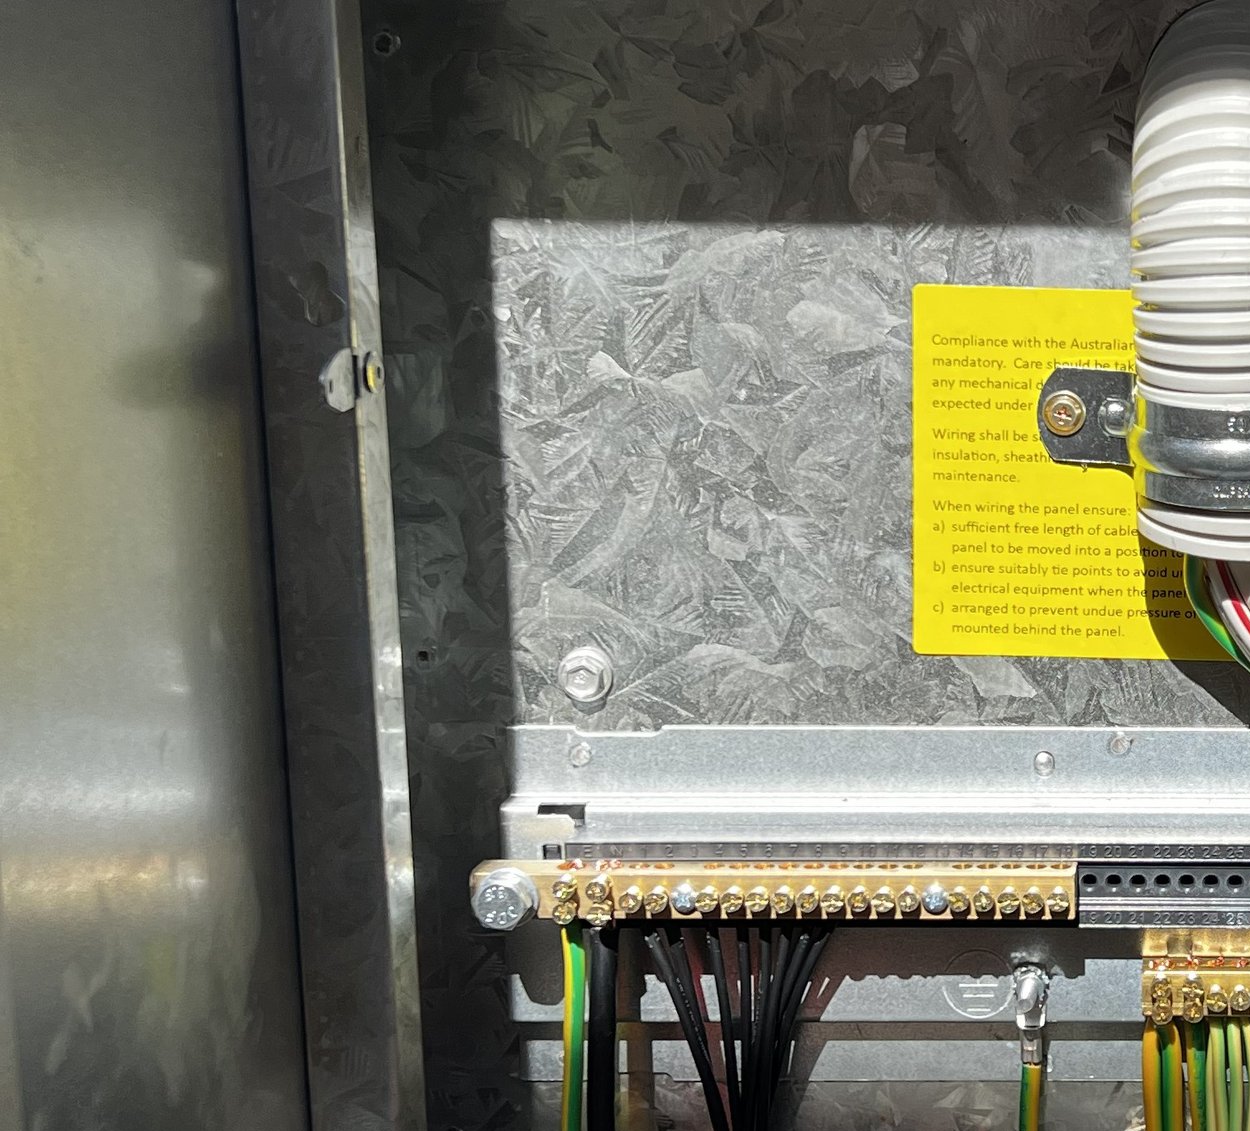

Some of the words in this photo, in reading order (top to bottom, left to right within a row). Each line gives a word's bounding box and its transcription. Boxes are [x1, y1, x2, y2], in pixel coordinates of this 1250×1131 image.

[931, 334, 1009, 348] Compliance
[1012, 336, 1041, 349] with
[1045, 336, 1067, 350] the
[932, 356, 1007, 370] mandatory.
[1013, 358, 1043, 370] Care
[1114, 361, 1135, 372] tak
[932, 378, 955, 391] any
[959, 378, 1032, 391] mechanical
[932, 398, 991, 413] expected
[995, 400, 1034, 412] under
[932, 429, 976, 443] Wiring
[979, 430, 1009, 442] shall
[1013, 430, 1029, 443] be
[932, 451, 1000, 465] insulation,
[1003, 452, 1051, 463] sheath
[932, 472, 1020, 484] maintenance.
[932, 500, 972, 512] When
[975, 502, 1015, 516] wiring
[1018, 503, 1040, 514] the
[1043, 504, 1079, 516] panel
[1082, 506, 1131, 516] ensure:
[932, 520, 945, 534] a)
[951, 521, 1011, 534] sufficient
[1014, 522, 1039, 534] free
[1043, 523, 1084, 537] length
[1087, 525, 1101, 536] of
[951, 541, 987, 554] panel
[991, 543, 1004, 554] to
[1008, 543, 1023, 554] be
[1027, 544, 1072, 555] moved
[1075, 545, 1101, 556] into
[1104, 547, 1112, 556] a
[1116, 546, 1167, 558] position
[932, 561, 946, 575] b)
[951, 564, 995, 574] ensure
[999, 563, 1049, 577] suitably
[1052, 565, 1069, 575] tie
[1073, 566, 1113, 578] points
[1117, 567, 1130, 577] to
[1133, 567, 1168, 578] avoid
[951, 582, 1010, 594] electrical
[1013, 584, 1084, 597] equipment
[1087, 586, 1124, 597] when
[1127, 587, 1148, 597] the
[932, 601, 944, 614] c)
[951, 603, 1009, 616] arranged
[1012, 605, 1026, 615] to
[1029, 605, 1079, 617] prevent
[1082, 606, 1123, 617] undue
[1127, 608, 1181, 619] pressure
[951, 623, 1009, 635] mounted
[1013, 623, 1057, 636] behind
[1060, 625, 1082, 637] the
[1086, 626, 1125, 638] panel.
[1080, 845, 1098, 858] 19
[1104, 845, 1122, 858] 20
[1128, 846, 1145, 858] 21
[1153, 846, 1172, 858] 22
[1202, 846, 1221, 859] 24
[1226, 846, 1245, 858] 25
[1104, 912, 1122, 924] 20
[1128, 912, 1145, 924] 21
[1153, 912, 1172, 924] 22
[1226, 912, 1245, 925] 25
